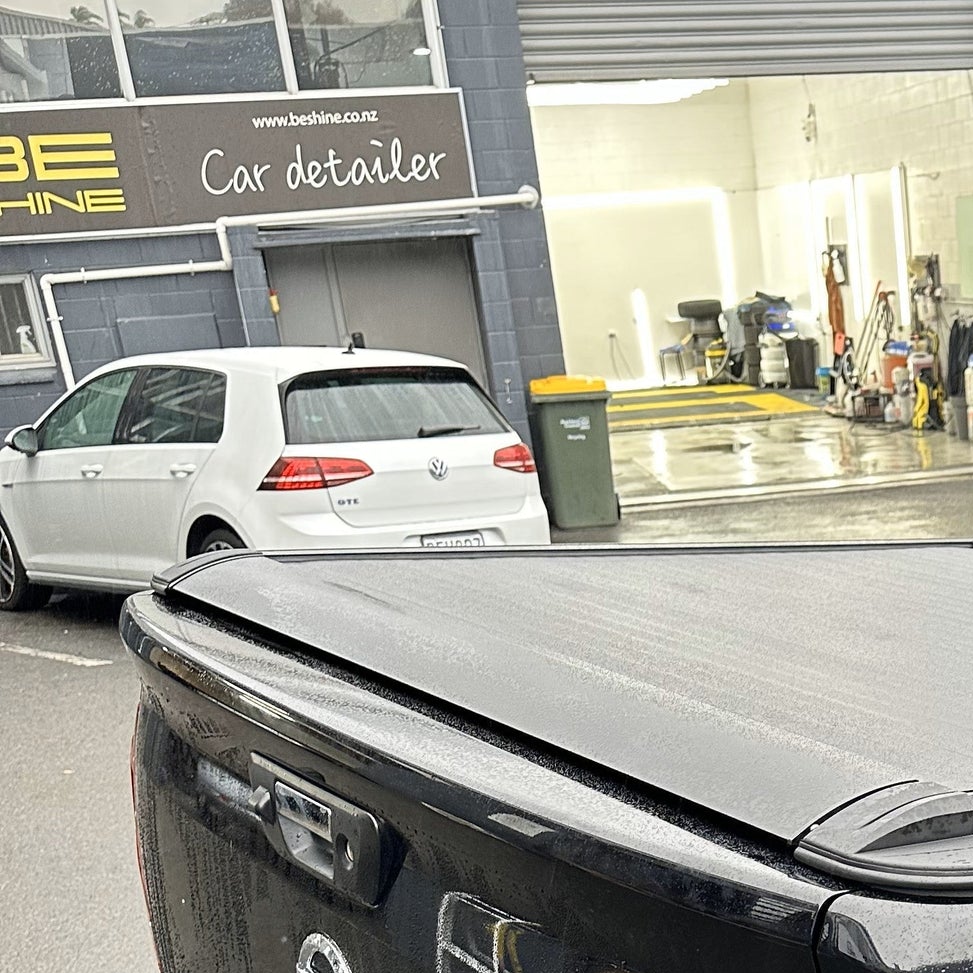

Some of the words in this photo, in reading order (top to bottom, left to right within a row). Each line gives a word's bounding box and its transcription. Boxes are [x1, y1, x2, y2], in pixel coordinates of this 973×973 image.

[251, 110, 379, 129] www.beshine.co.nz
[200, 149, 271, 195] Car
[286, 137, 447, 190] detailer
[337, 498, 360, 506] GTE
